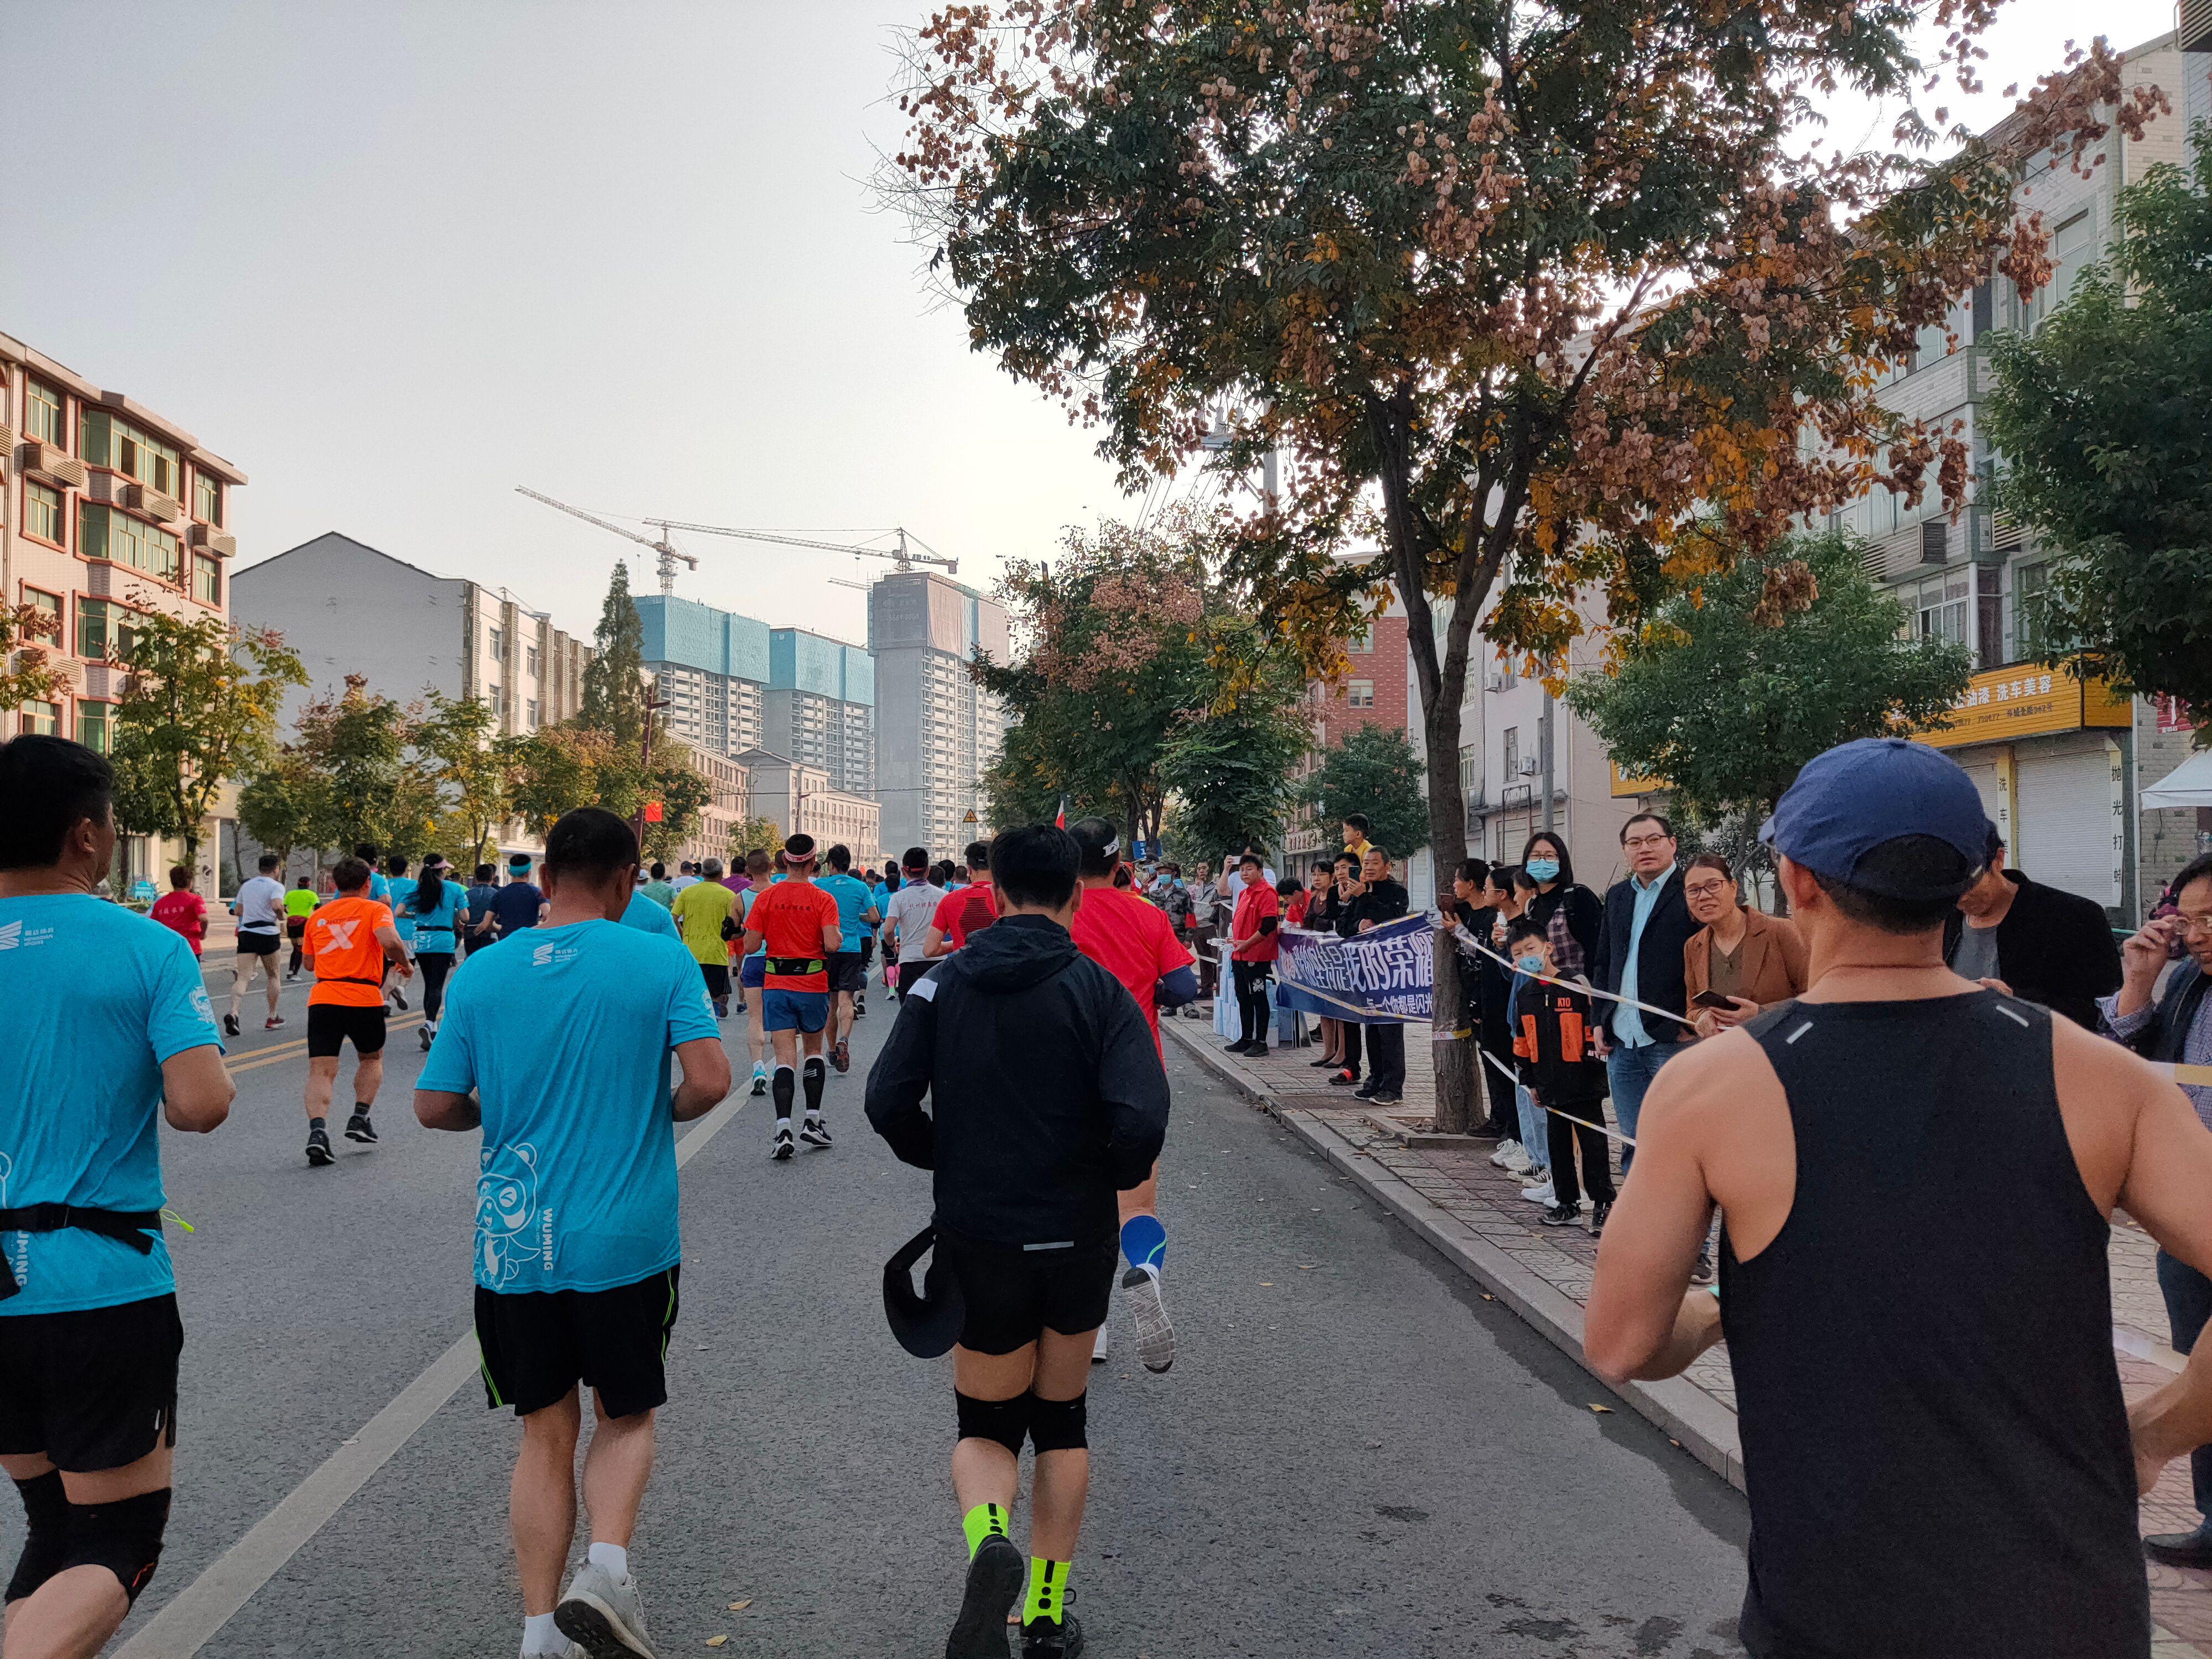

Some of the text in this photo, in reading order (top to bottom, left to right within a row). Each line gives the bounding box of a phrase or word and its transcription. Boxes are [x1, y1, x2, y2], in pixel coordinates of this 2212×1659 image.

[1996, 674, 2052, 702] 洗车美容
[1557, 997, 1571, 1008] K10
[542, 1208, 554, 1271] WUMING
